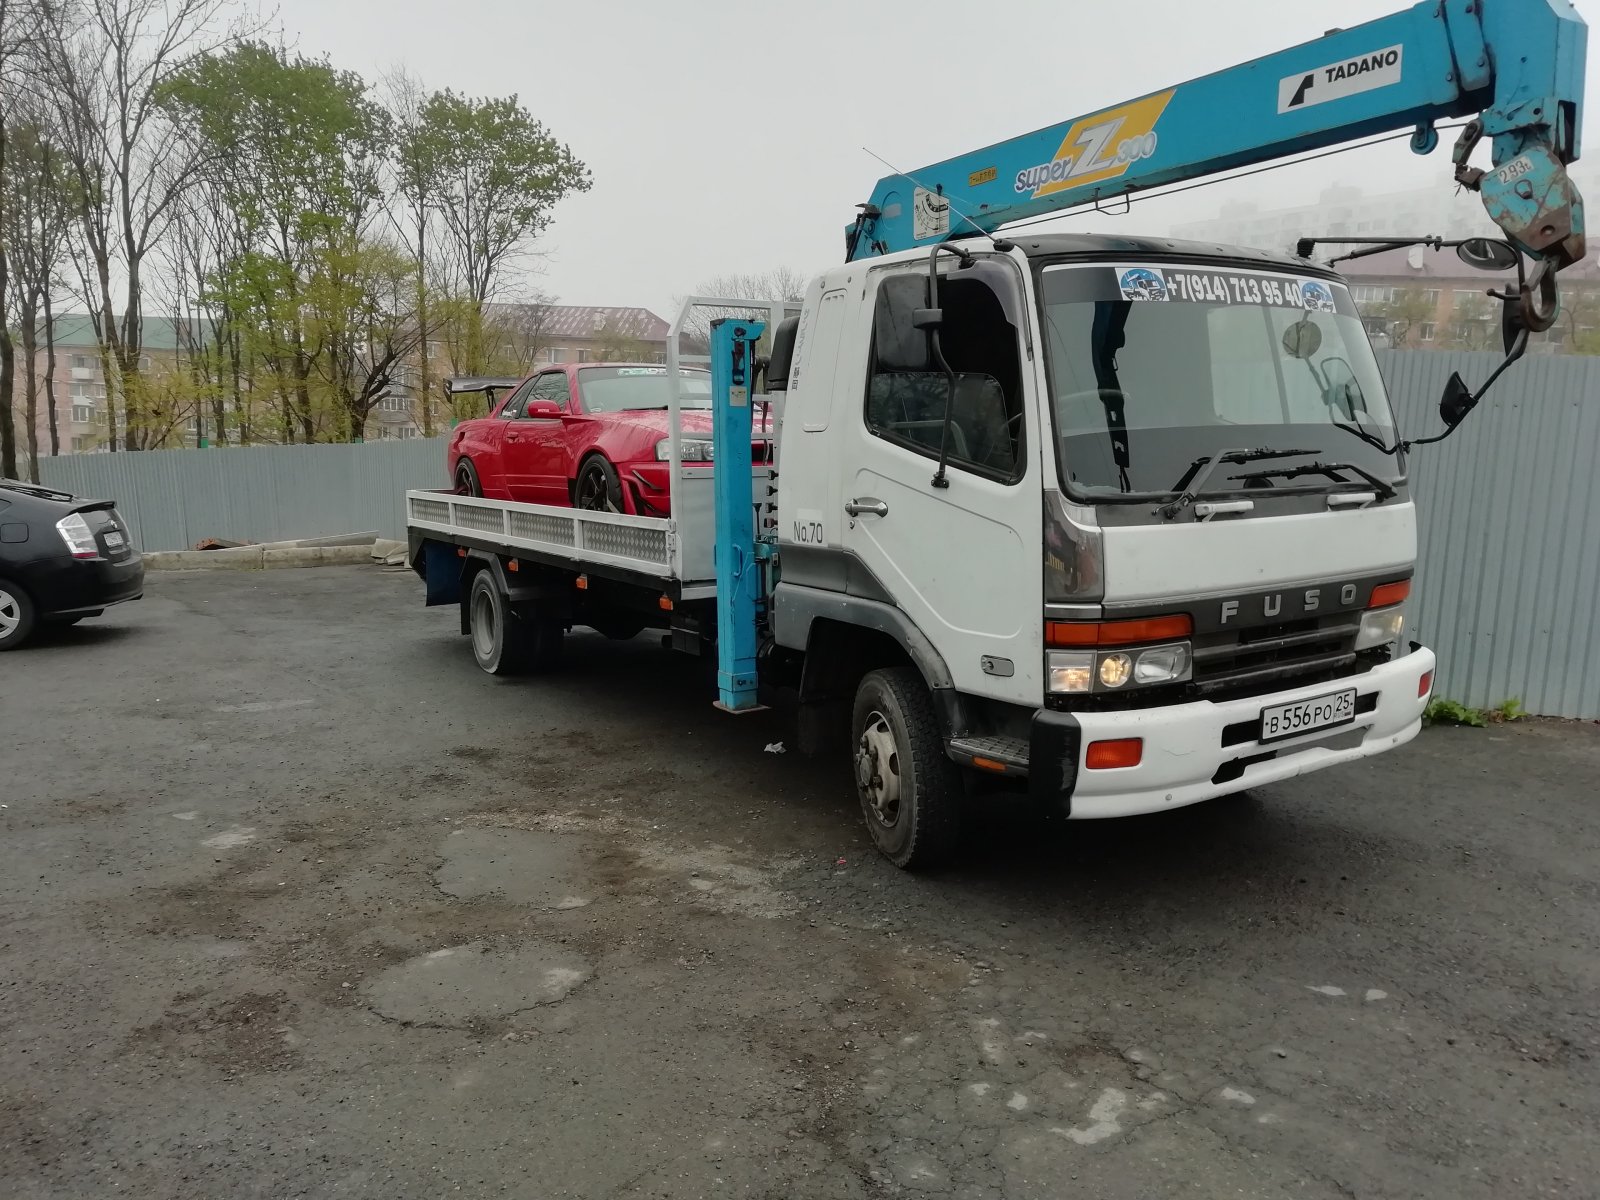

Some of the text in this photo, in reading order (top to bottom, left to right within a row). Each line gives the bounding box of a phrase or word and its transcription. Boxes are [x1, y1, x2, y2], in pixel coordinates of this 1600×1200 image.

[1325, 49, 1398, 83] TADANO
[1015, 157, 1072, 191] super
[1066, 116, 1128, 179] Z
[1118, 132, 1157, 163] 300
[1166, 274, 1303, 307] +7(914) 713 95 40
[793, 520, 823, 544] No.70
[1221, 583, 1357, 624] FUSO
[1335, 693, 1350, 712] 25
